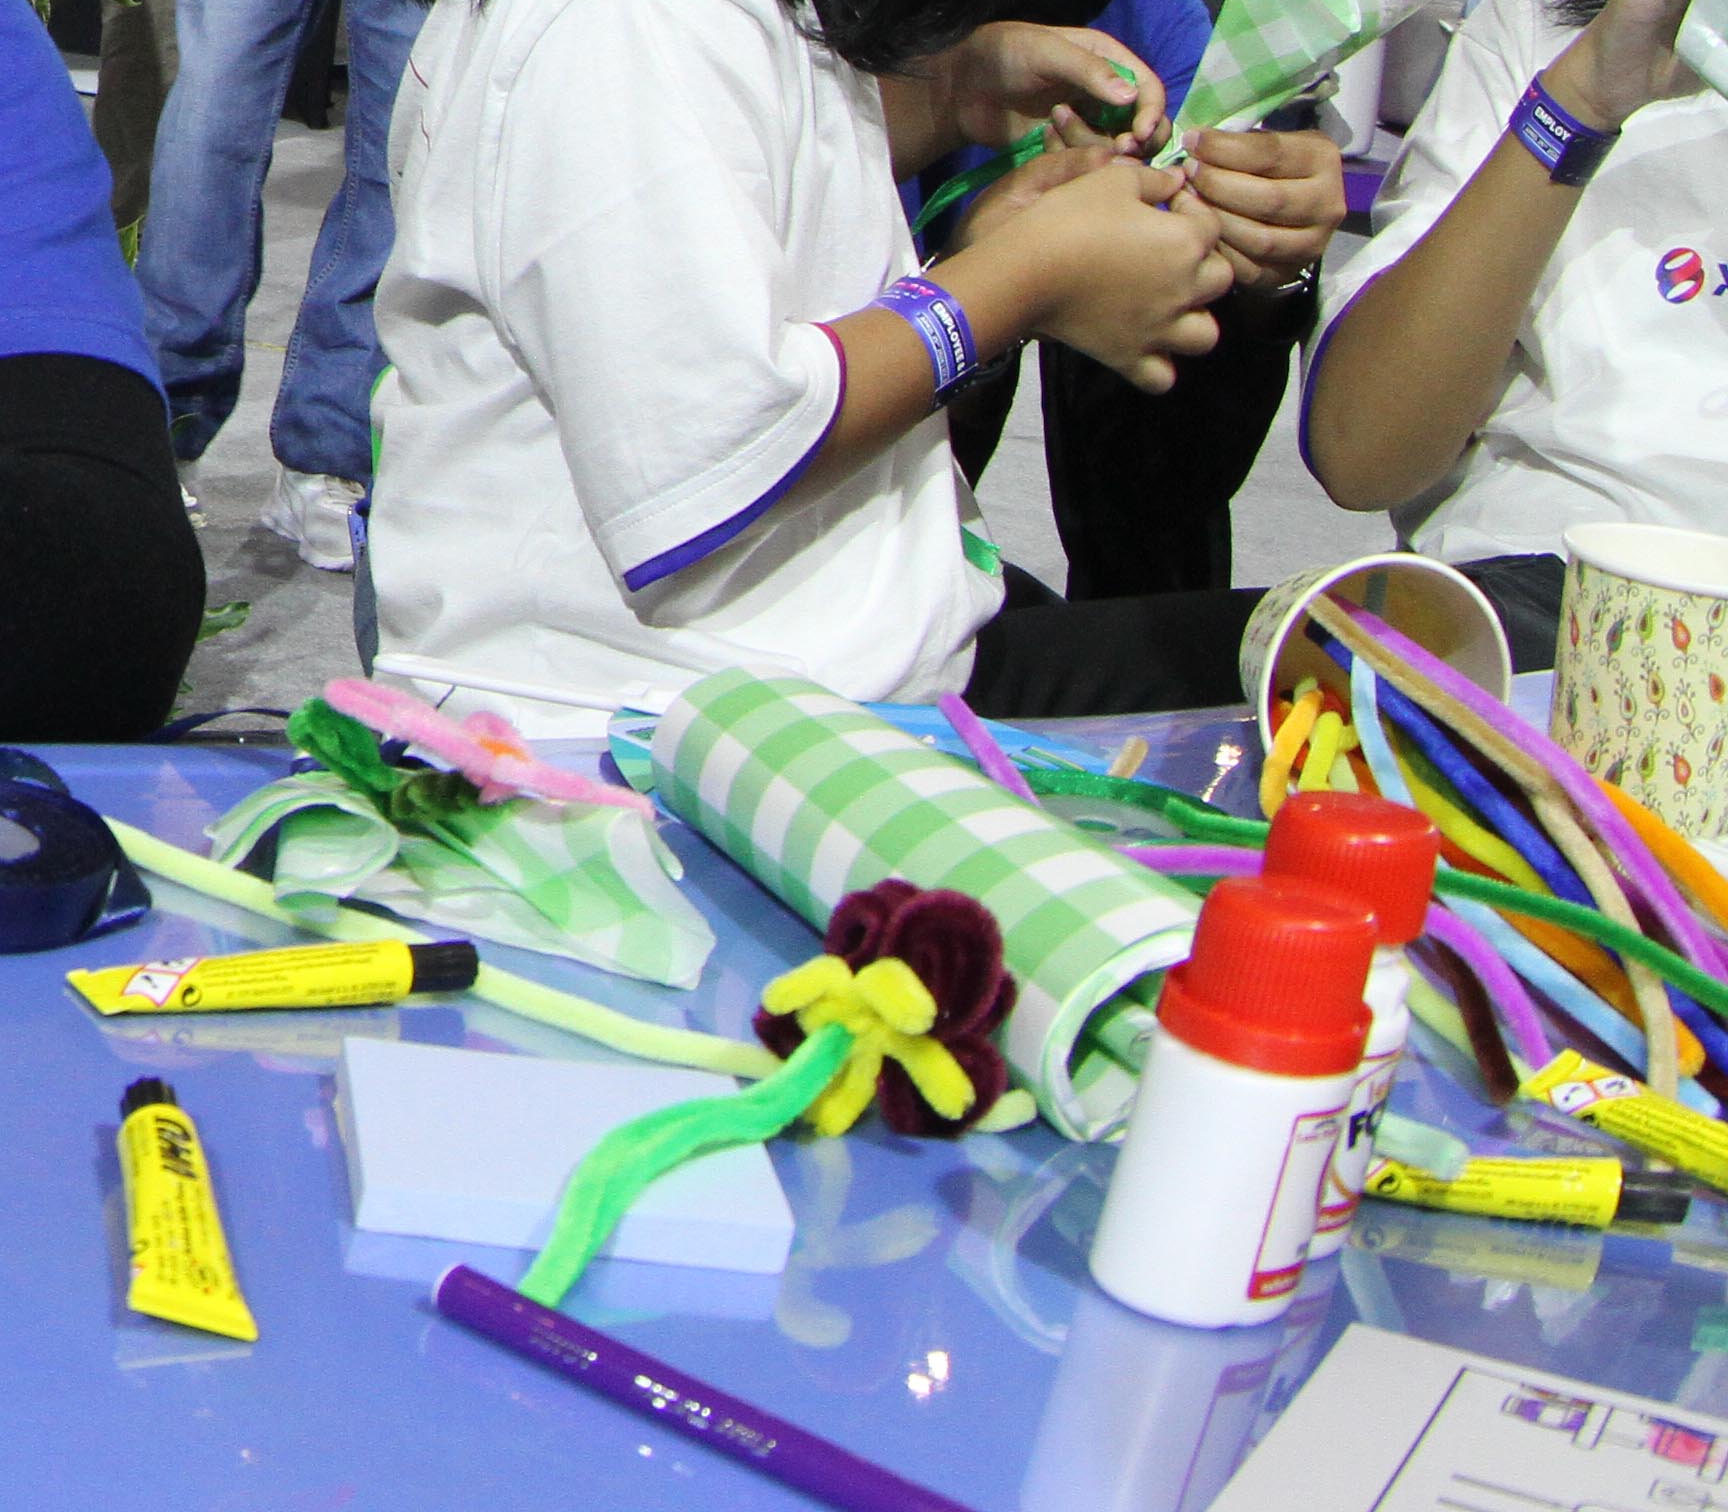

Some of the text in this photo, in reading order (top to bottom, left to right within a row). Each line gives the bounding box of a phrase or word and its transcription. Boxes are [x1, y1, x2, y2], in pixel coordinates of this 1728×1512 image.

[1534, 105, 1572, 141] EMPLOY
[932, 302, 965, 364] EMPLOYEE
[154, 1114, 199, 1182] UHU
